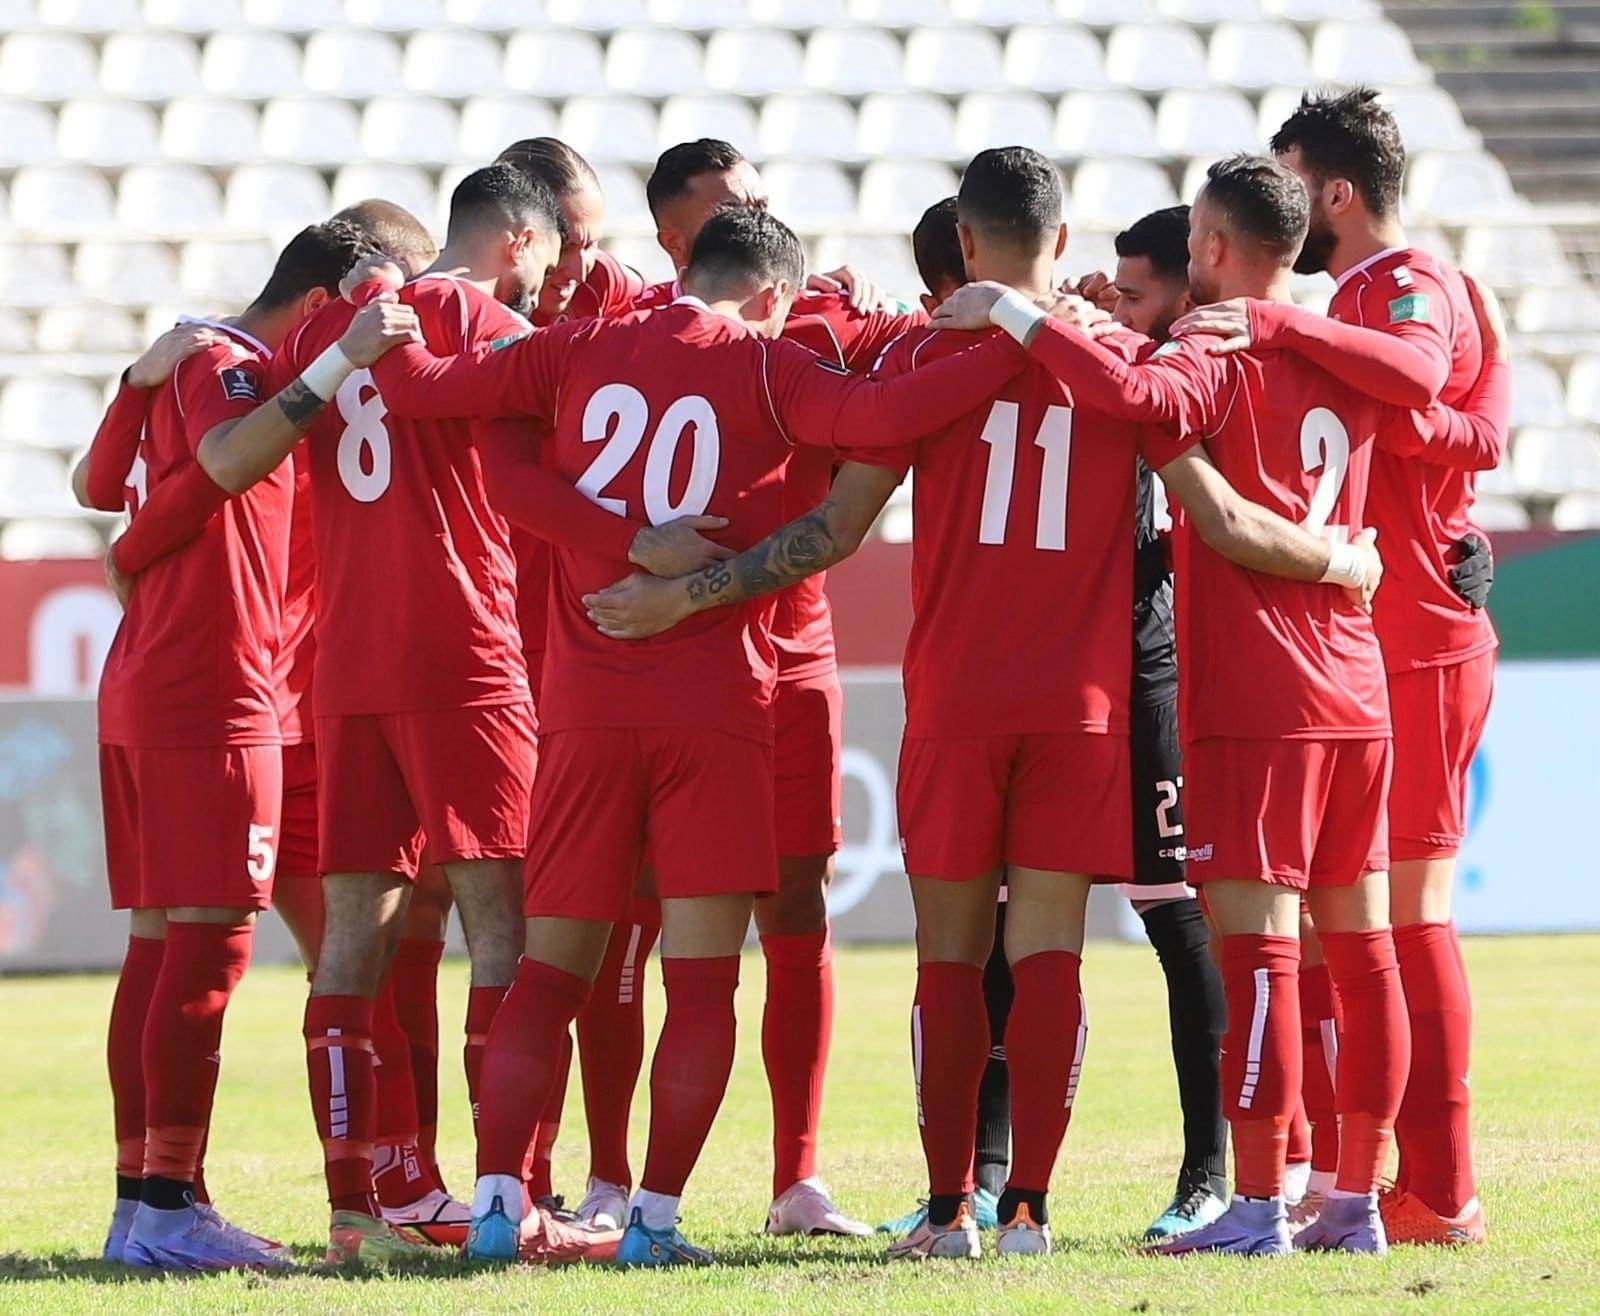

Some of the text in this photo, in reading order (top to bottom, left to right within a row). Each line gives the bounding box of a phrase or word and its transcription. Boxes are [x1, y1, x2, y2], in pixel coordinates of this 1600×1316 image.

[335, 366, 391, 502] 8
[575, 383, 720, 528] 20
[979, 400, 1073, 551] 11
[1300, 406, 1351, 545] 2
[246, 823, 274, 881] 5
[1155, 775, 1184, 838] 2
